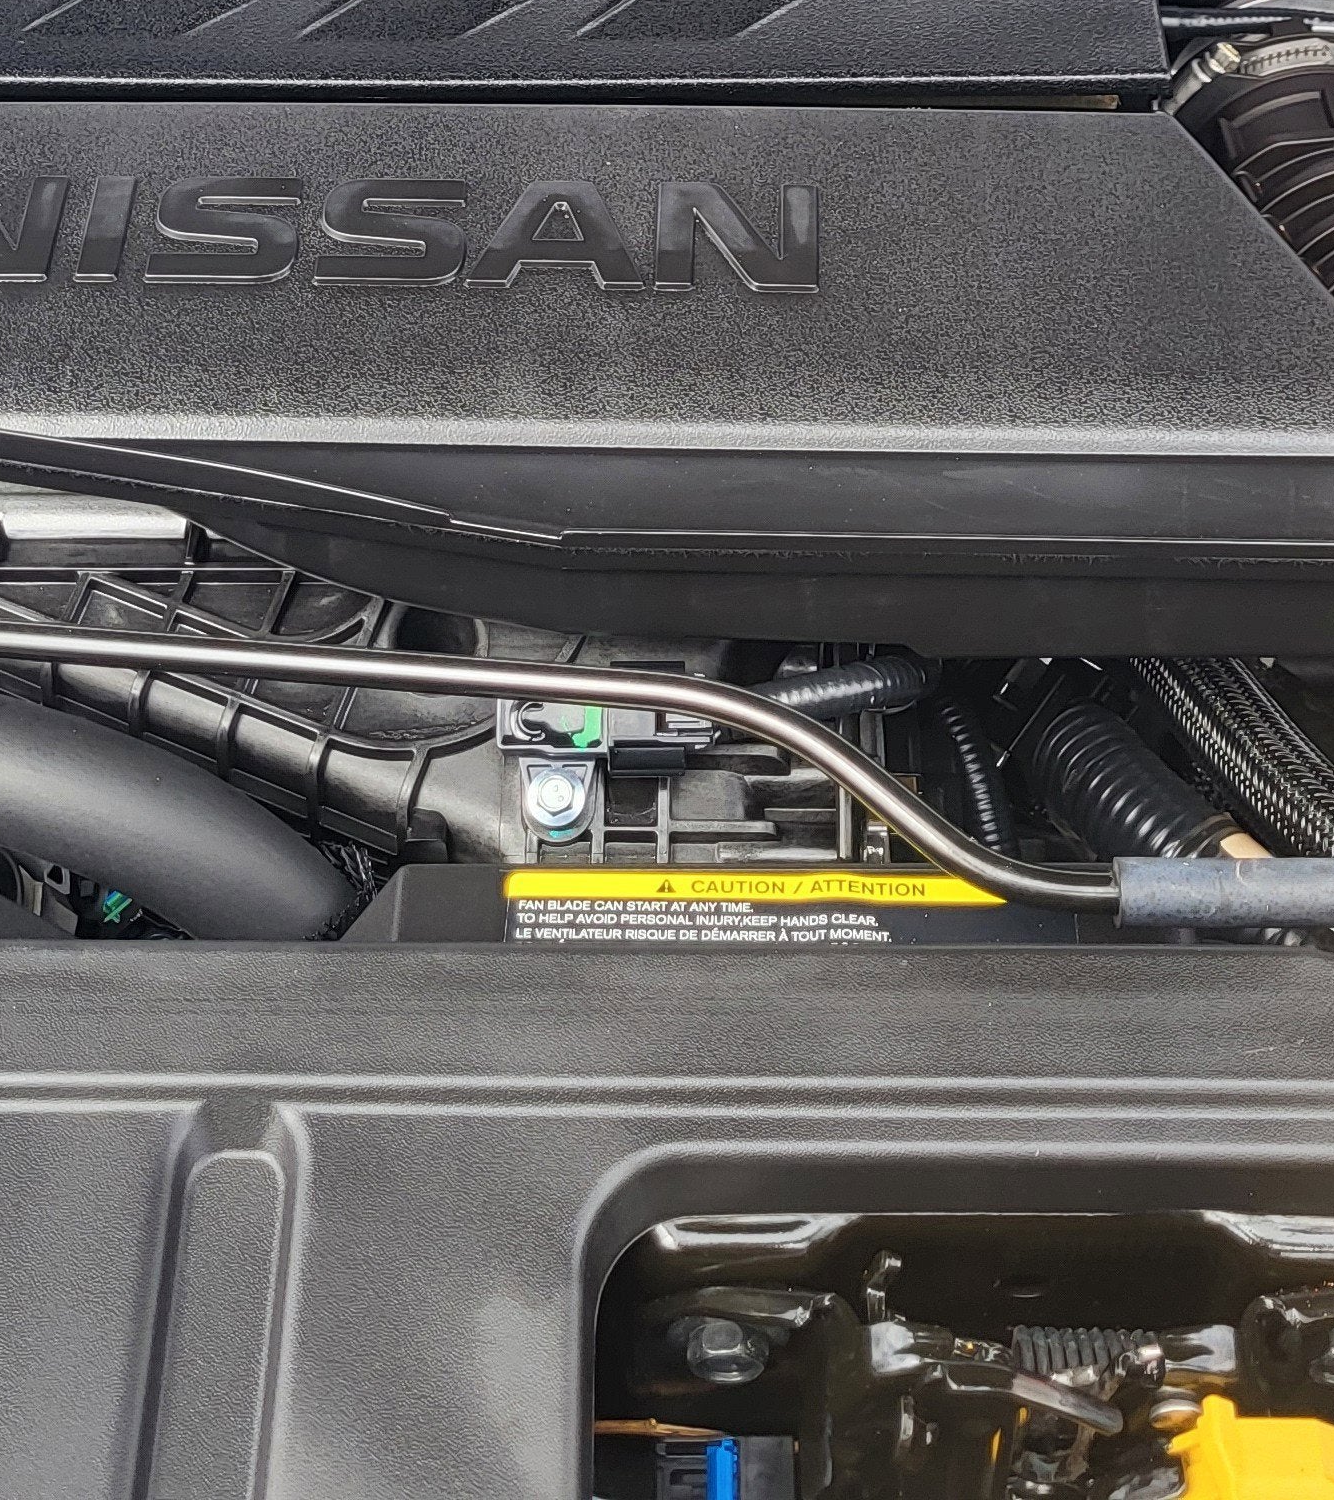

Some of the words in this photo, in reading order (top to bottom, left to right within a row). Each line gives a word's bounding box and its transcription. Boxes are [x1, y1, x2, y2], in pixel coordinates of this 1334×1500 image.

[691, 880, 785, 895] CAUTION
[810, 879, 926, 897] ATTENTION
[518, 900, 544, 911] FAN
[547, 900, 590, 911] BLADE
[595, 901, 623, 911] CAN
[626, 901, 668, 911] START
[670, 902, 686, 912] AT
[689, 902, 717, 912] ANY
[518, 913, 536, 924] TO
[539, 913, 573, 924] HELP
[575, 913, 617, 925] AVOID
[621, 914, 693, 925] PERSONAL
[780, 914, 828, 926] HANDS
[516, 928, 531, 939] LE
[535, 928, 622, 940] VENTILATEUR
[625, 930, 676, 941] RISQUE
[679, 930, 698, 941] DE
[701, 927, 775, 942] DÉMARRER
[778, 927, 788, 942] À
[791, 929, 827, 942] TOUT
